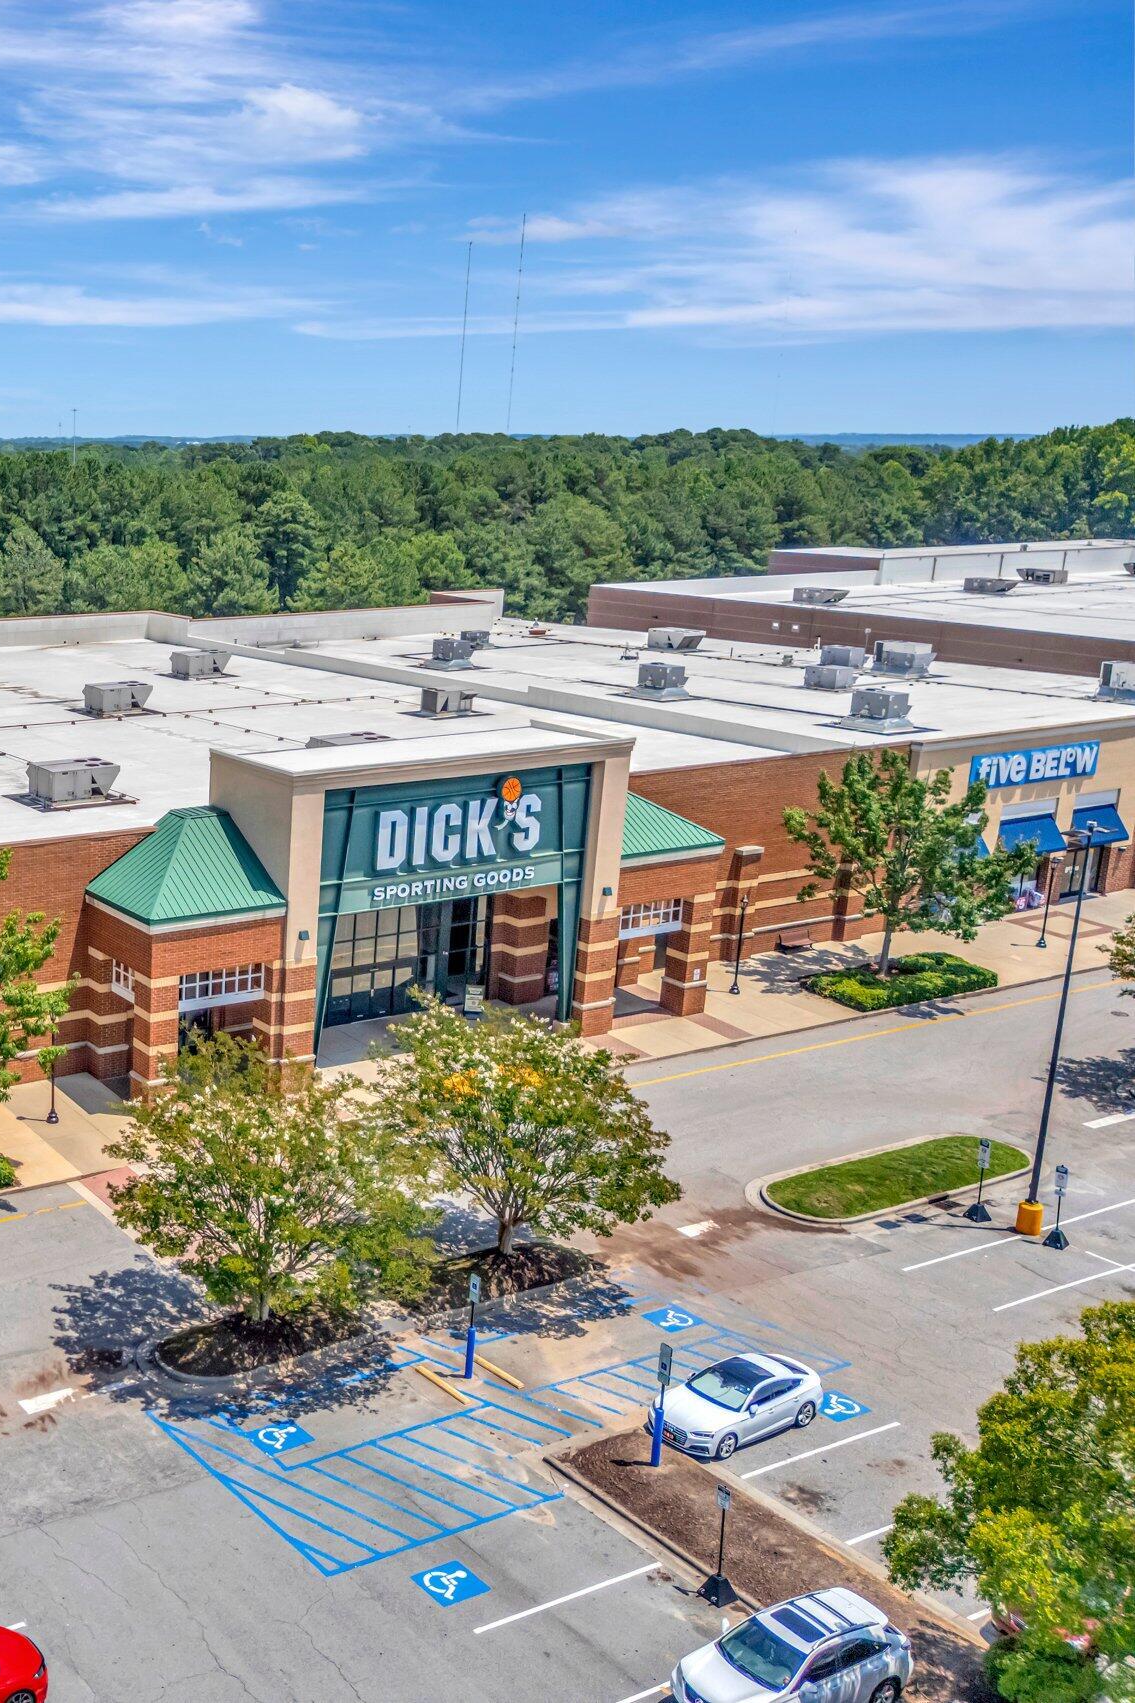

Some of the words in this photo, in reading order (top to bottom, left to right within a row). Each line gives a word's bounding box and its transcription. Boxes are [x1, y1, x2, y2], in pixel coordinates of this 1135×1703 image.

[376, 786, 542, 870] DICK'S
[373, 875, 468, 901] SPORTING
[473, 866, 535, 887] GOODS
